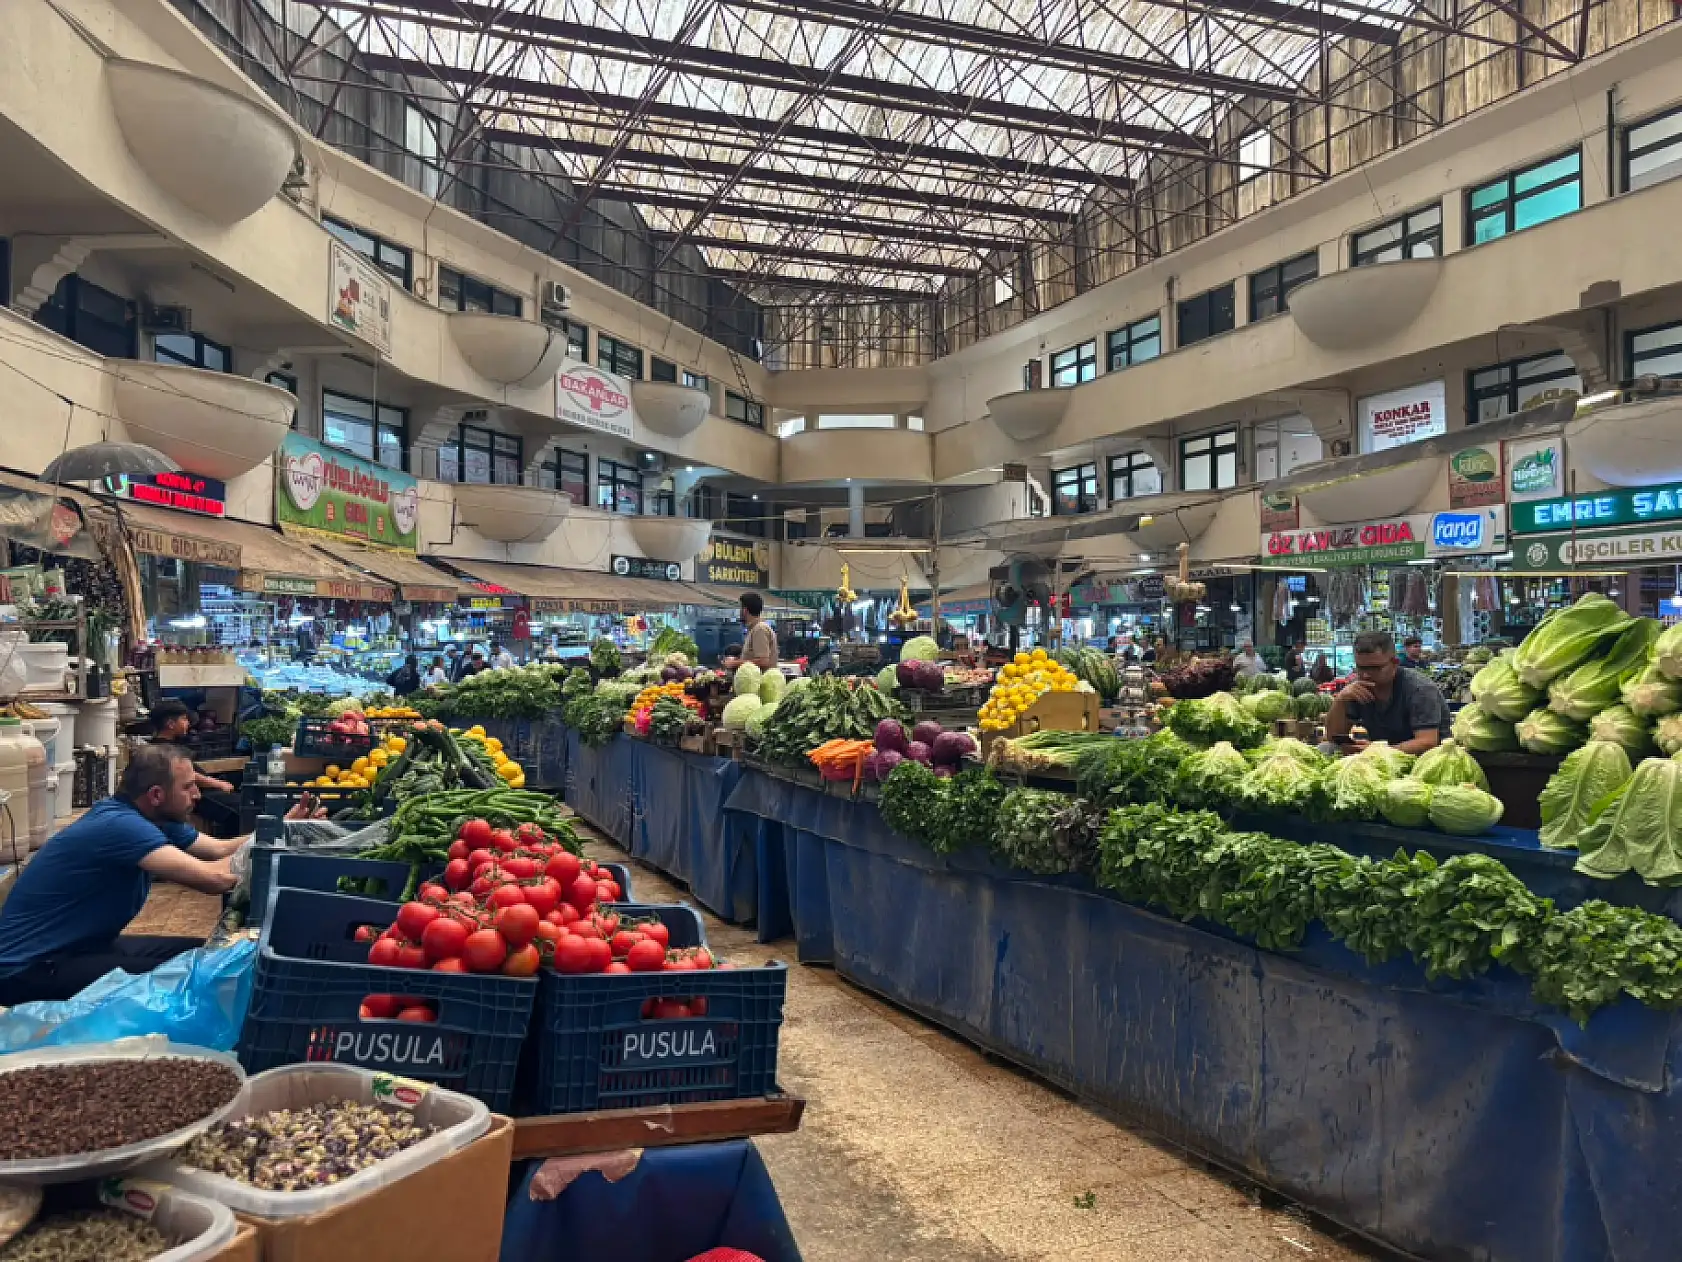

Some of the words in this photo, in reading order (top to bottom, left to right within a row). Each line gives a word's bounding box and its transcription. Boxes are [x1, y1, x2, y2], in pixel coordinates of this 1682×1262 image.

[1534, 497, 1614, 525] EMRE
[1268, 530, 1293, 555] ÖZ
[1297, 527, 1358, 552] YAVUZ
[1360, 521, 1414, 545] GIDA
[334, 1030, 444, 1064] PUSULA
[623, 1028, 716, 1061] PUSULA
